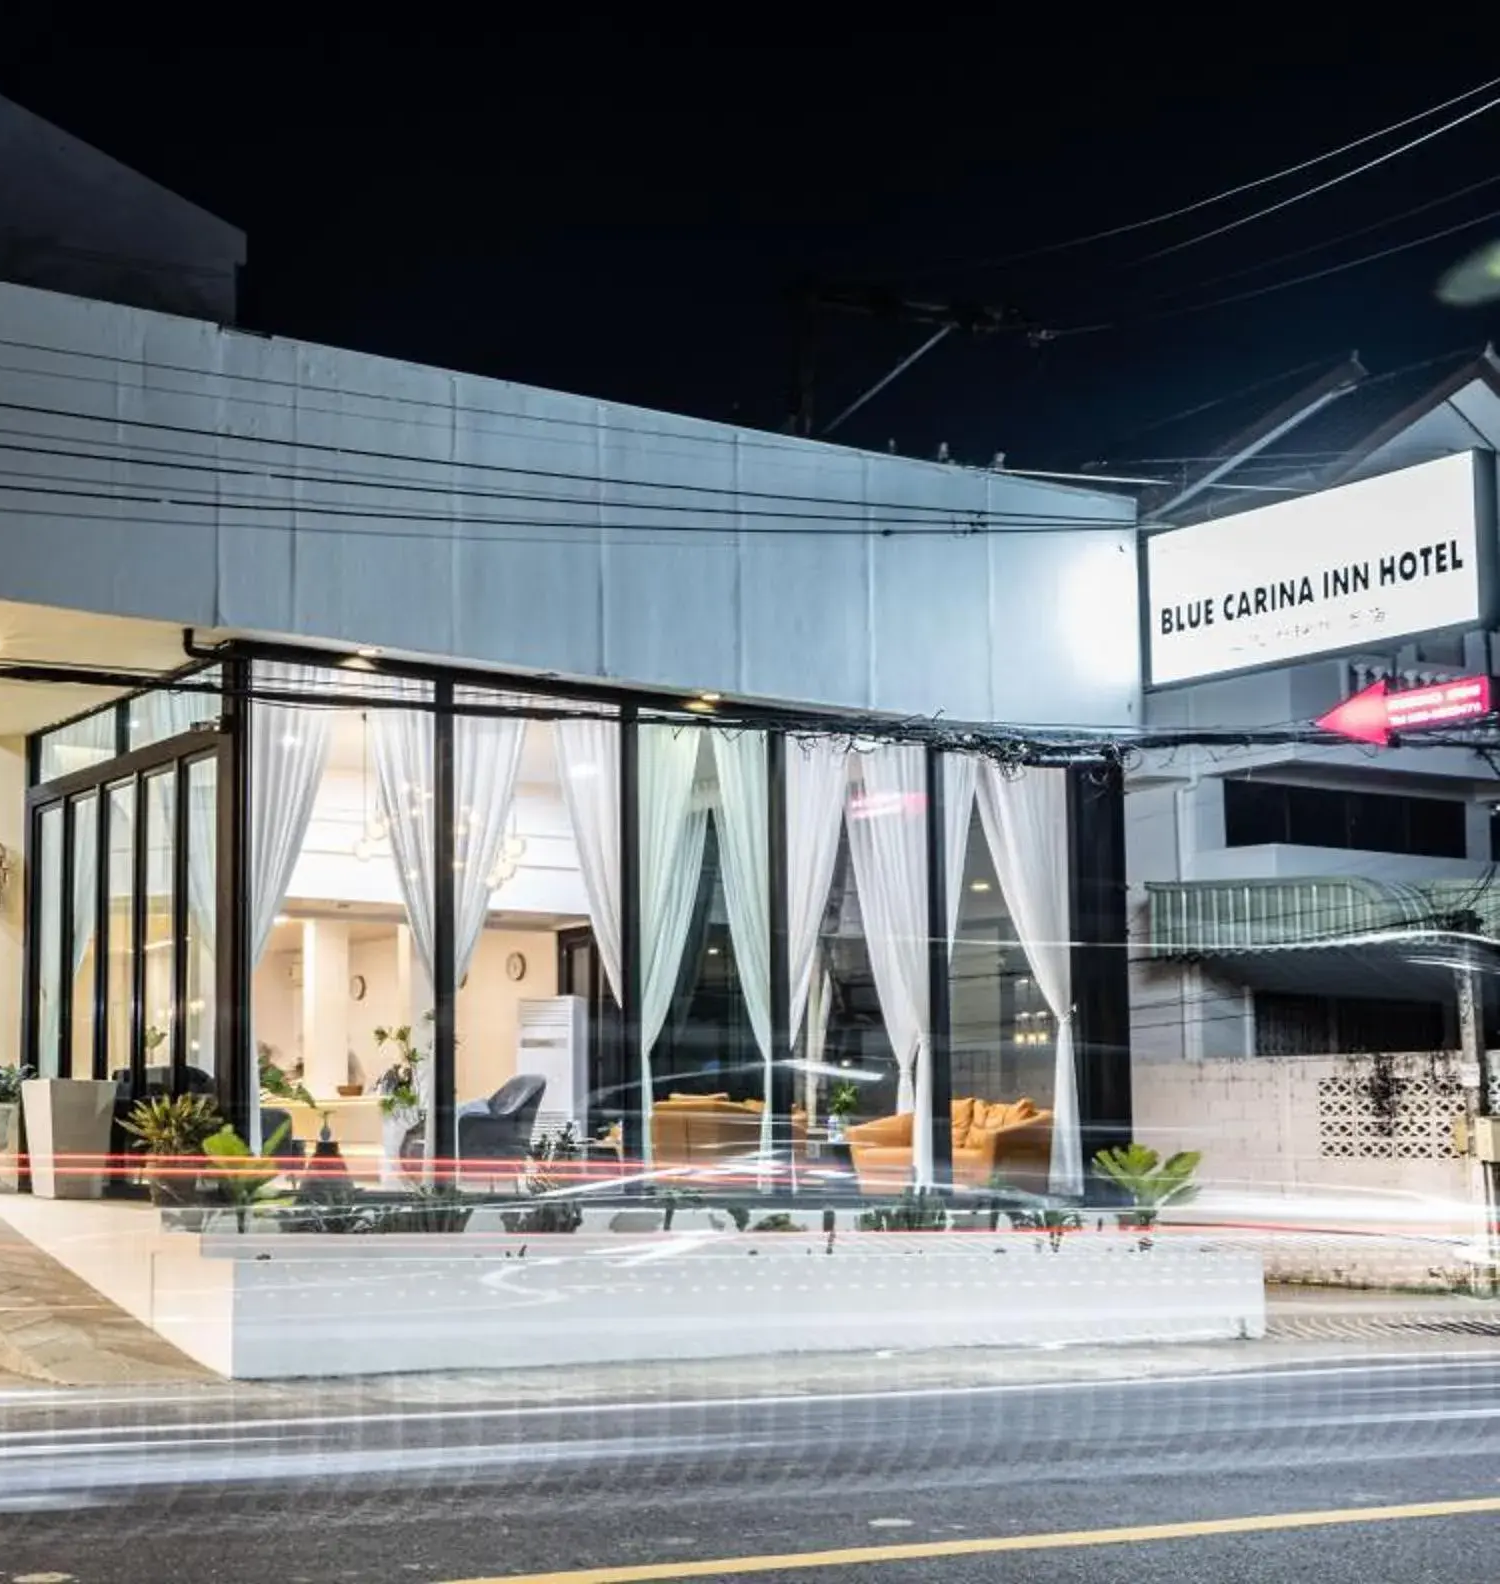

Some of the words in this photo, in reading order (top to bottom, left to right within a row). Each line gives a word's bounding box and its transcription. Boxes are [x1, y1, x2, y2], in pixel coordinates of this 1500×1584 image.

[1161, 600, 1214, 634] BLUE
[1223, 576, 1314, 620] CARINA
[1324, 562, 1369, 599] INN
[1380, 540, 1463, 586] HOTEL
